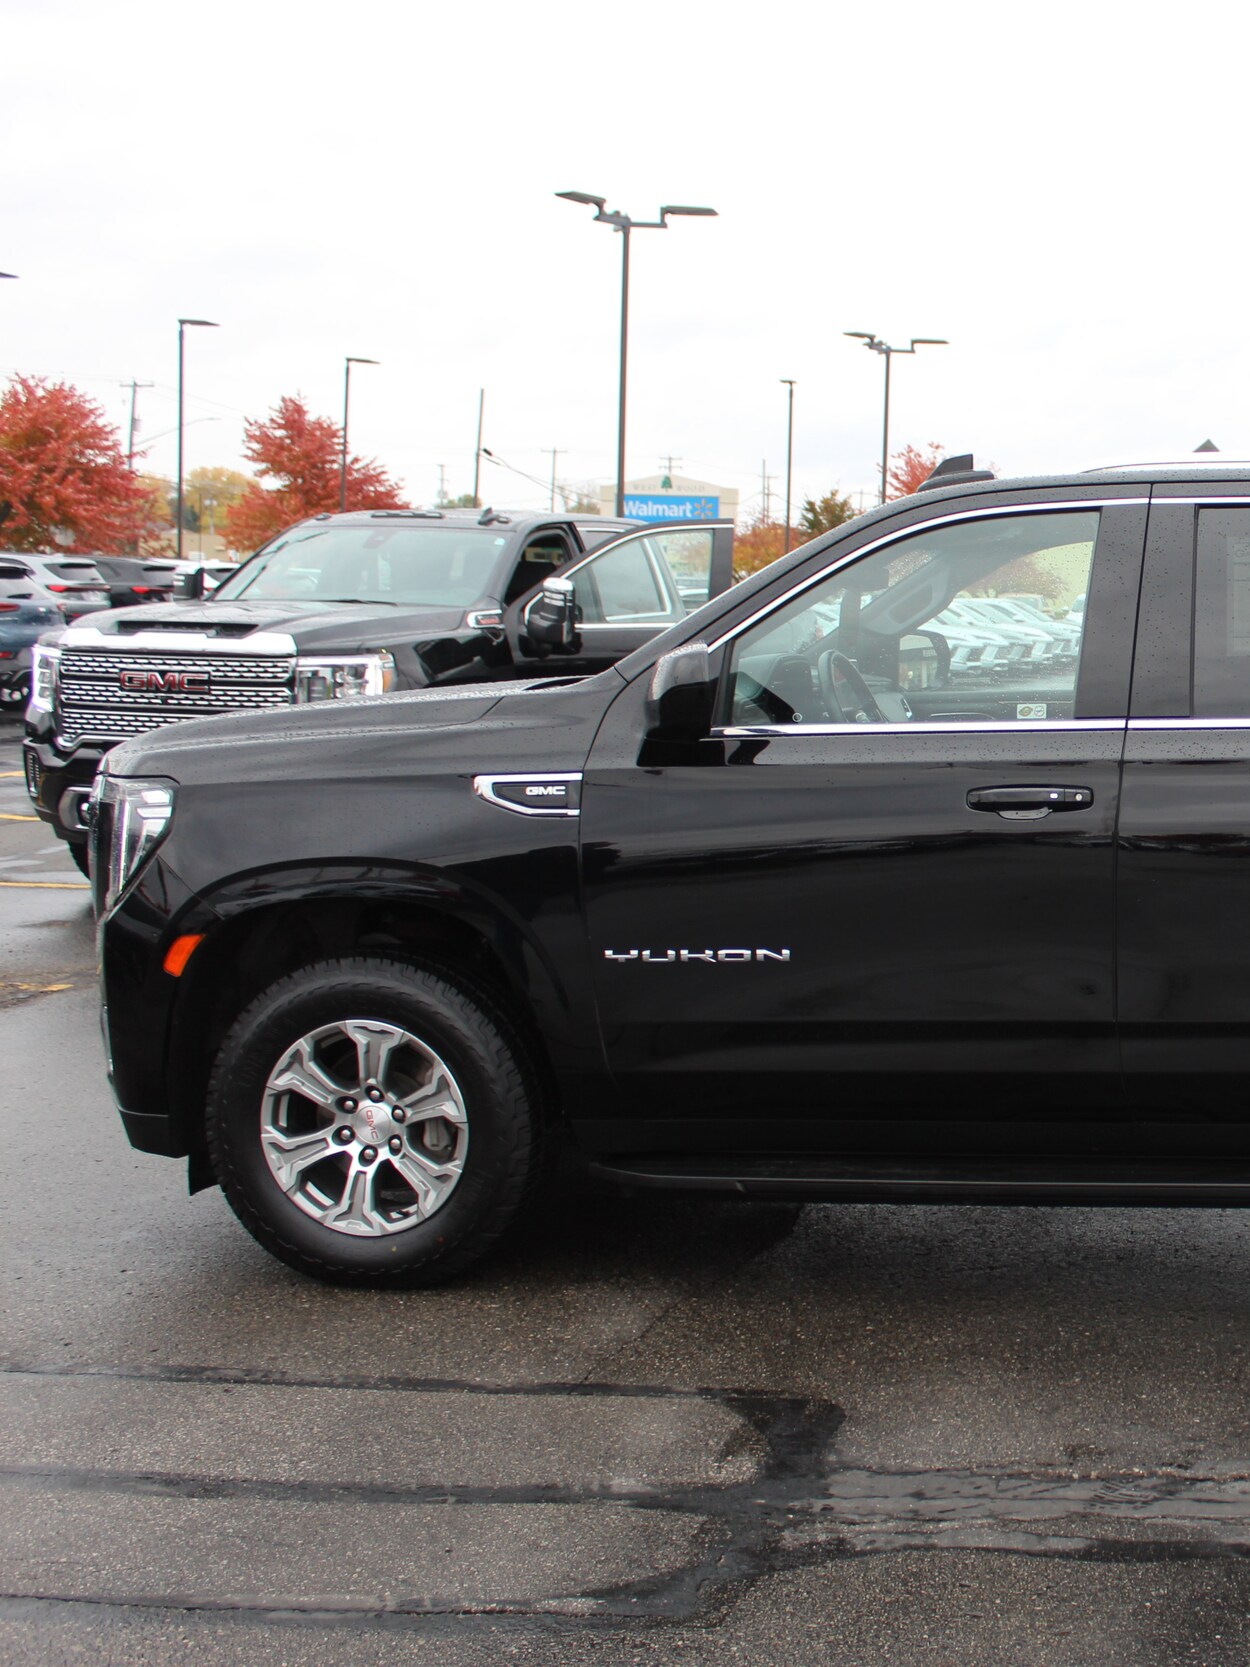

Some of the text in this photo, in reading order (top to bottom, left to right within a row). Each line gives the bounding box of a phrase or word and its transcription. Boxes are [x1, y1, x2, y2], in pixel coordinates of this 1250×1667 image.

[623, 500, 693, 517] Walmart
[120, 671, 210, 692] GMC
[525, 786, 566, 796] GMC
[604, 949, 791, 963] YUKON
[366, 1110, 379, 1140] GMC
